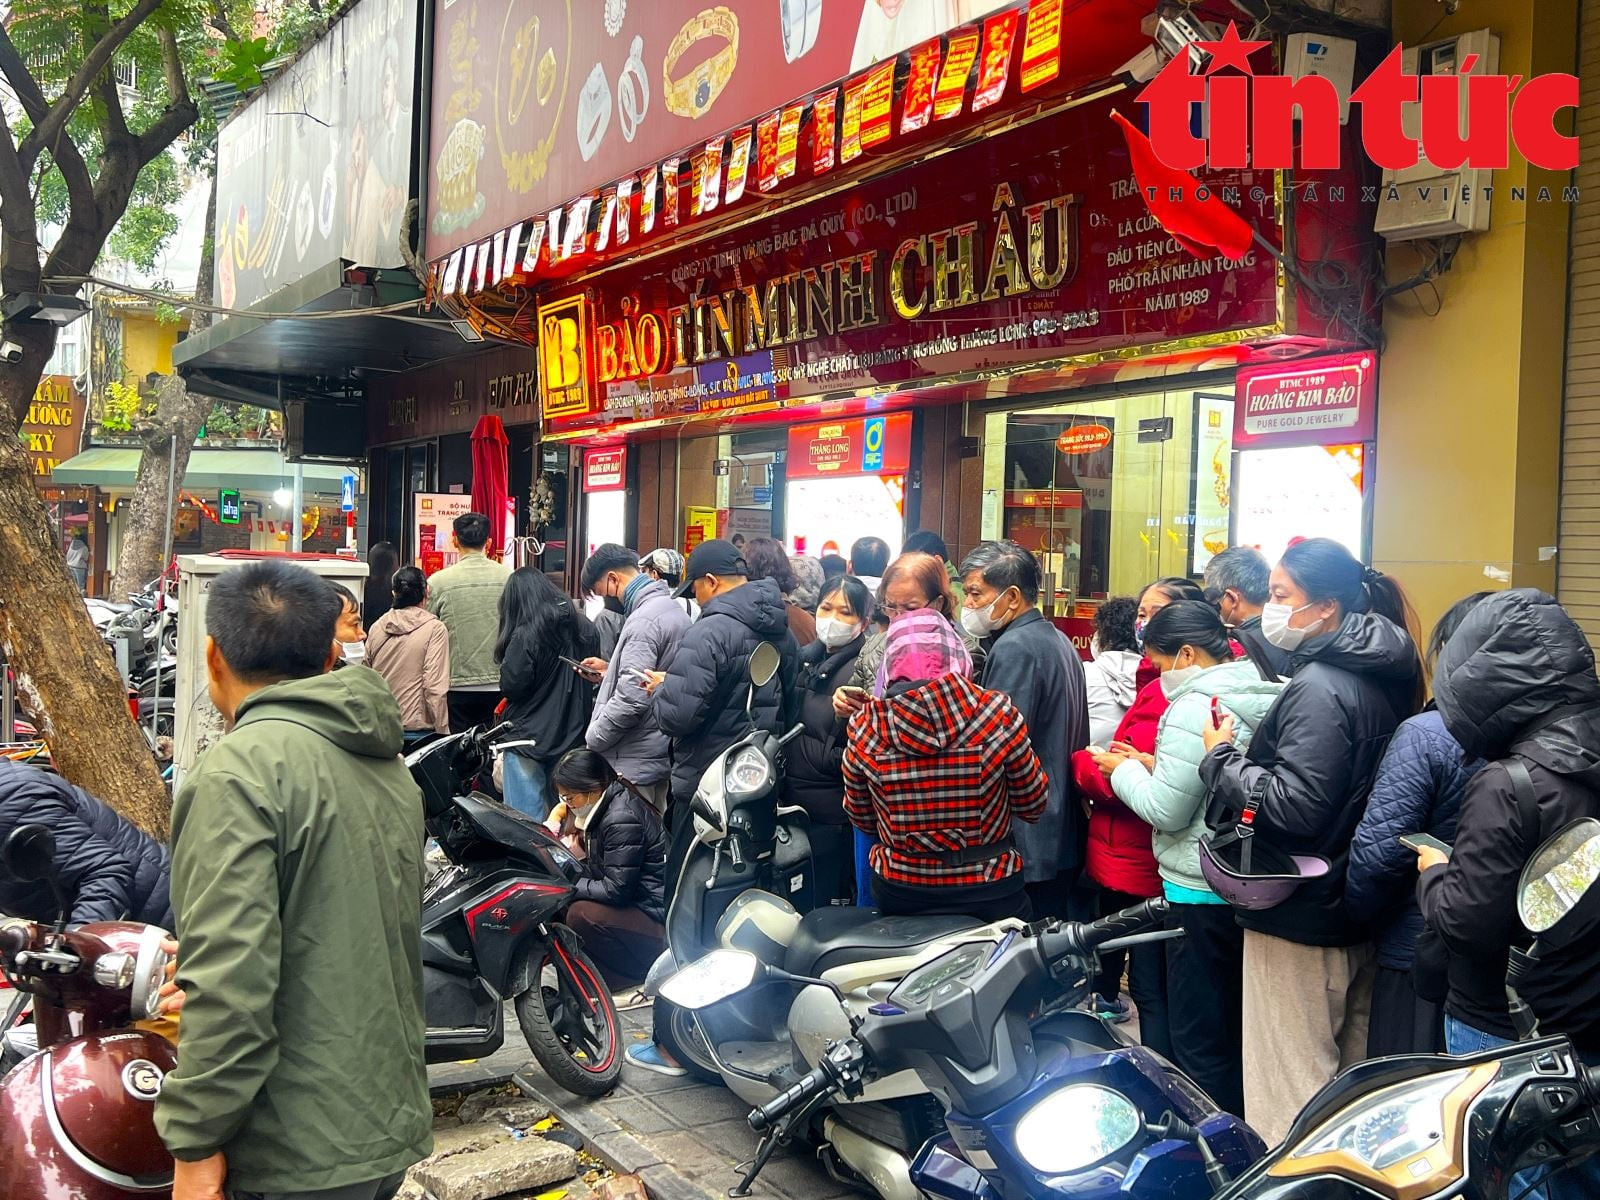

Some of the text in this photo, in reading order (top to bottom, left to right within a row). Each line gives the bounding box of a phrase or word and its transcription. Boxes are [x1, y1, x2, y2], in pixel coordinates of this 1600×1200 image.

[1118, 218, 1133, 238] LÀ
[1172, 258, 1212, 282] NHÂN
[597, 181, 1074, 383] BẢO TÍN MINH CHÂU
[1145, 288, 1209, 313] NĂM 1989
[1279, 375, 1326, 389] BTMC 1989
[1249, 381, 1356, 412] HOÀNG KIM BẢO
[1257, 412, 1344, 429] PURE GOLD JEWELRY
[29, 429, 56, 453] KỲ
[832, 442, 849, 455] LONG
[223, 500, 238, 516] aha
